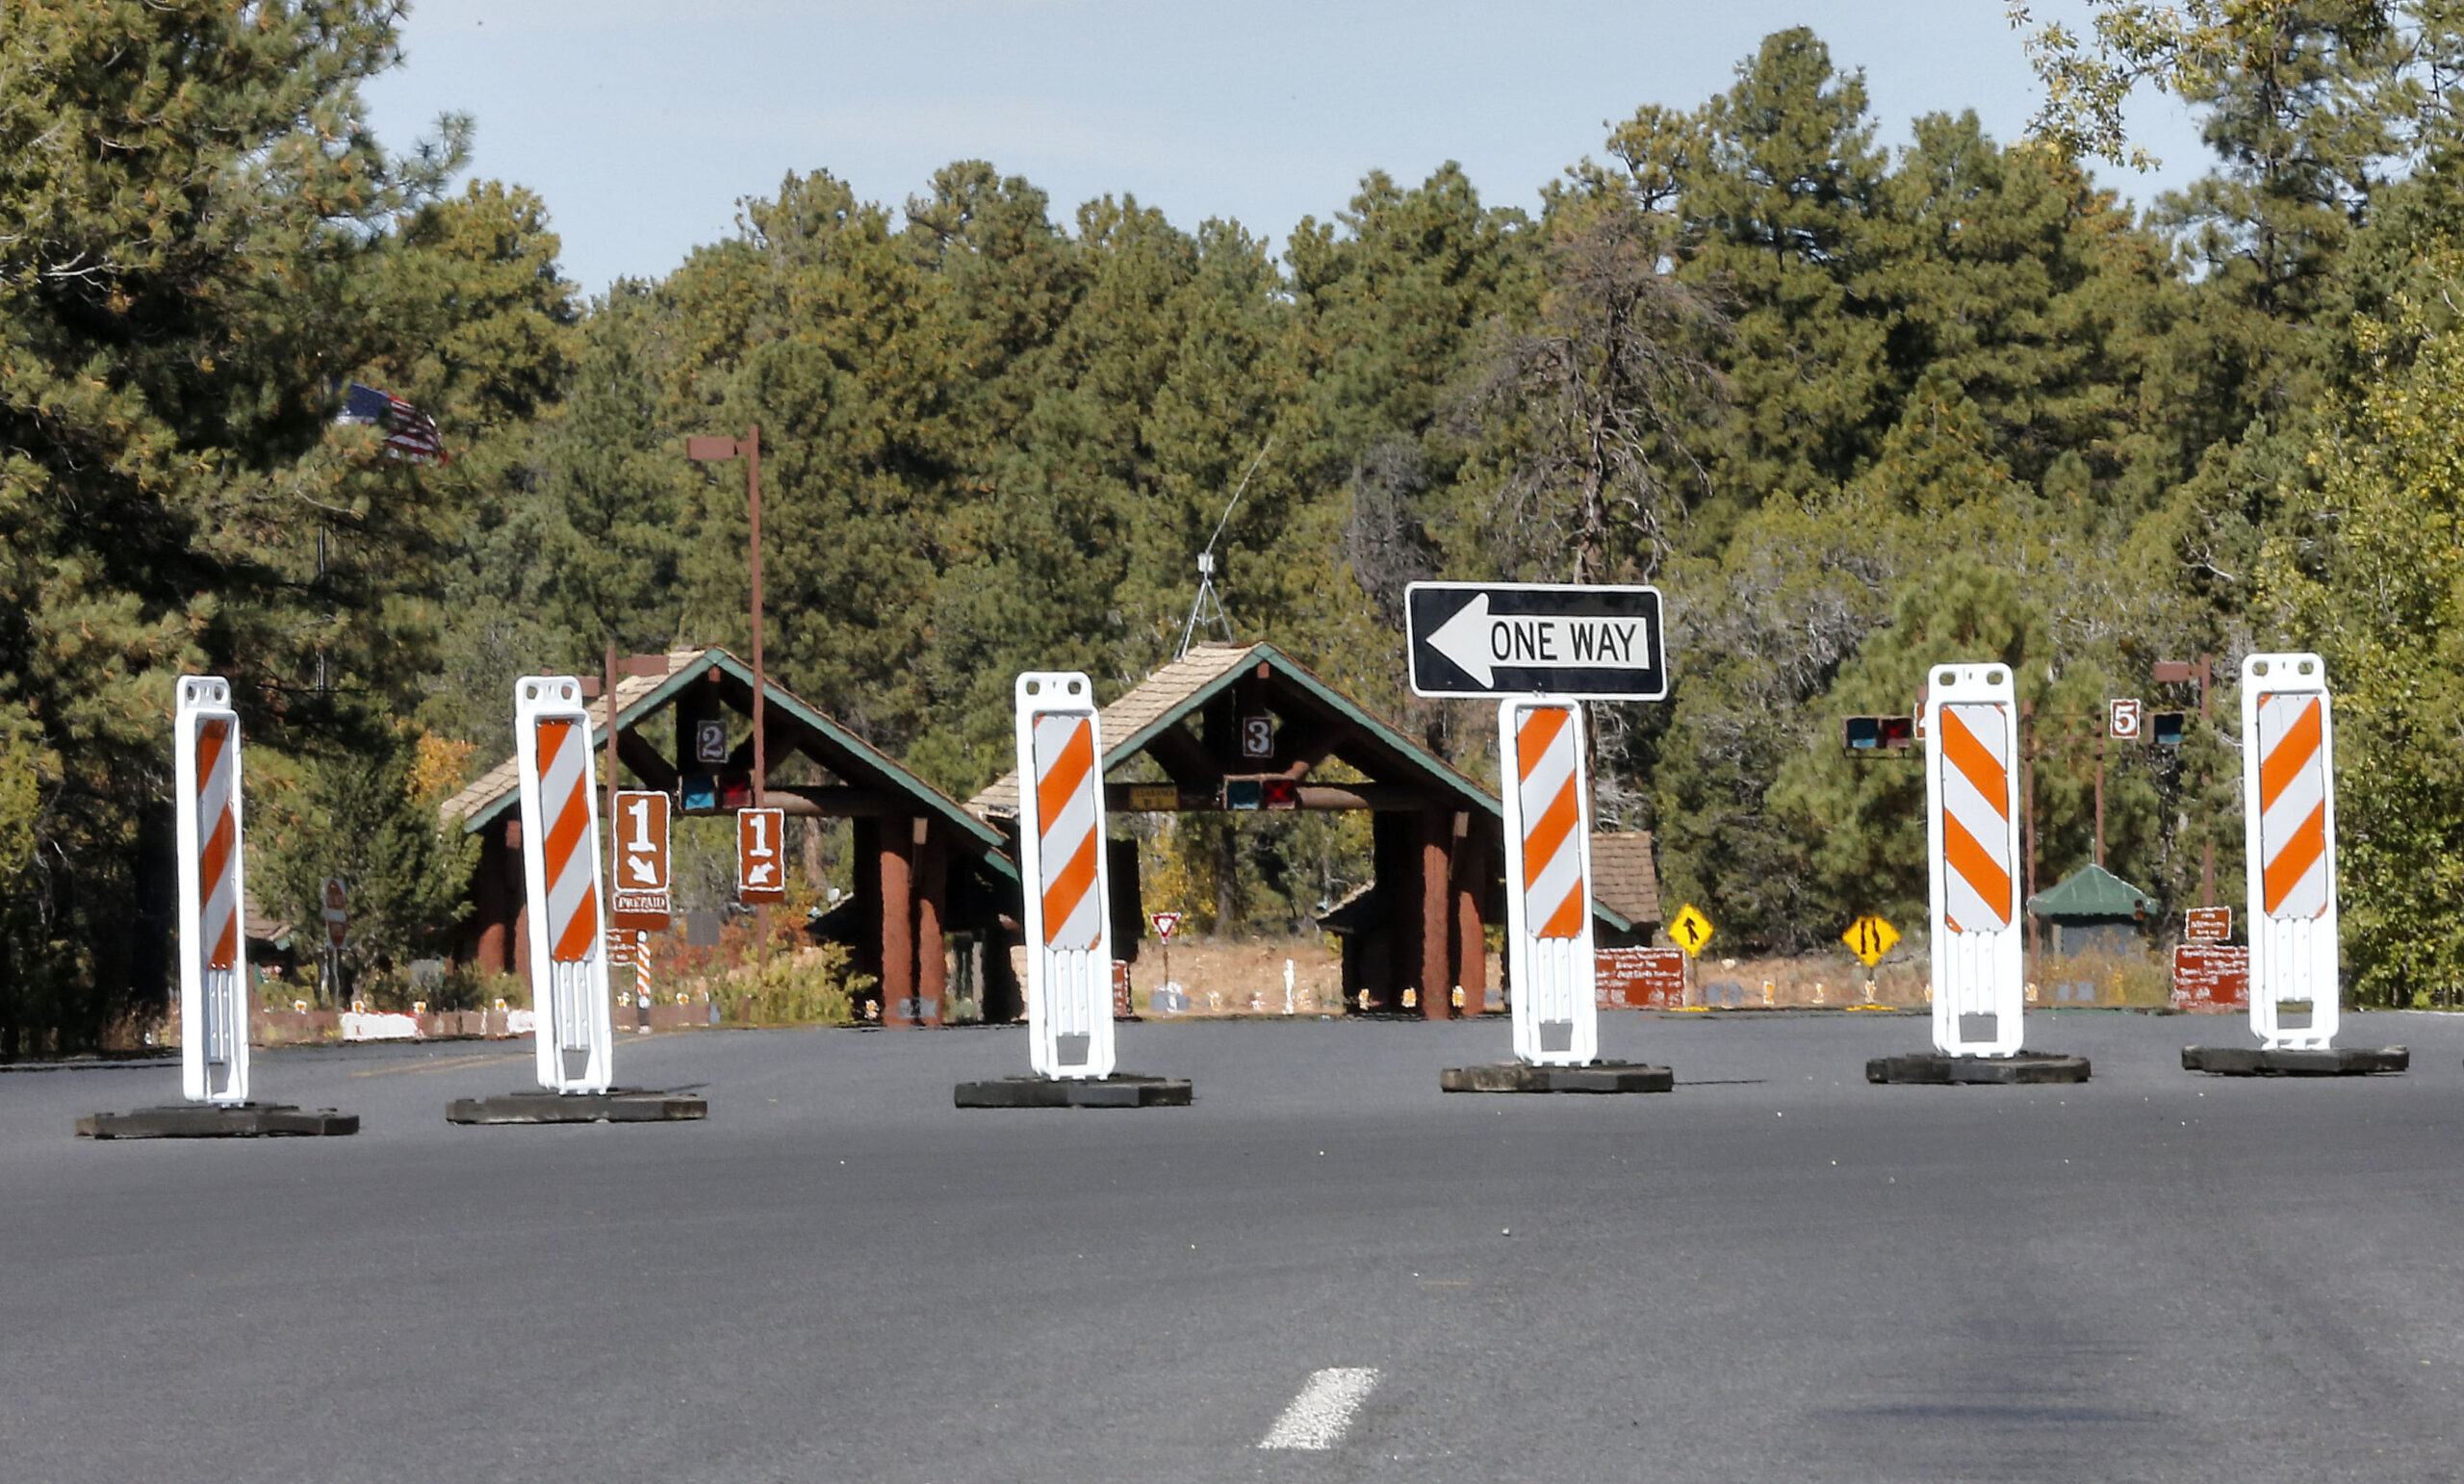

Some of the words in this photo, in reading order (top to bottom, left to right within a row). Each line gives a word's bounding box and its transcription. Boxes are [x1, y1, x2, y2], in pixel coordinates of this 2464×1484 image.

[1491, 621, 1558, 661] ONE
[1570, 622, 1637, 662] WAY
[1247, 720, 1270, 755] 3
[2114, 705, 2136, 735] 5
[702, 726, 725, 756] 2
[627, 798, 658, 853] 1
[748, 813, 774, 857] 1
[618, 896, 665, 909] PREPAID
